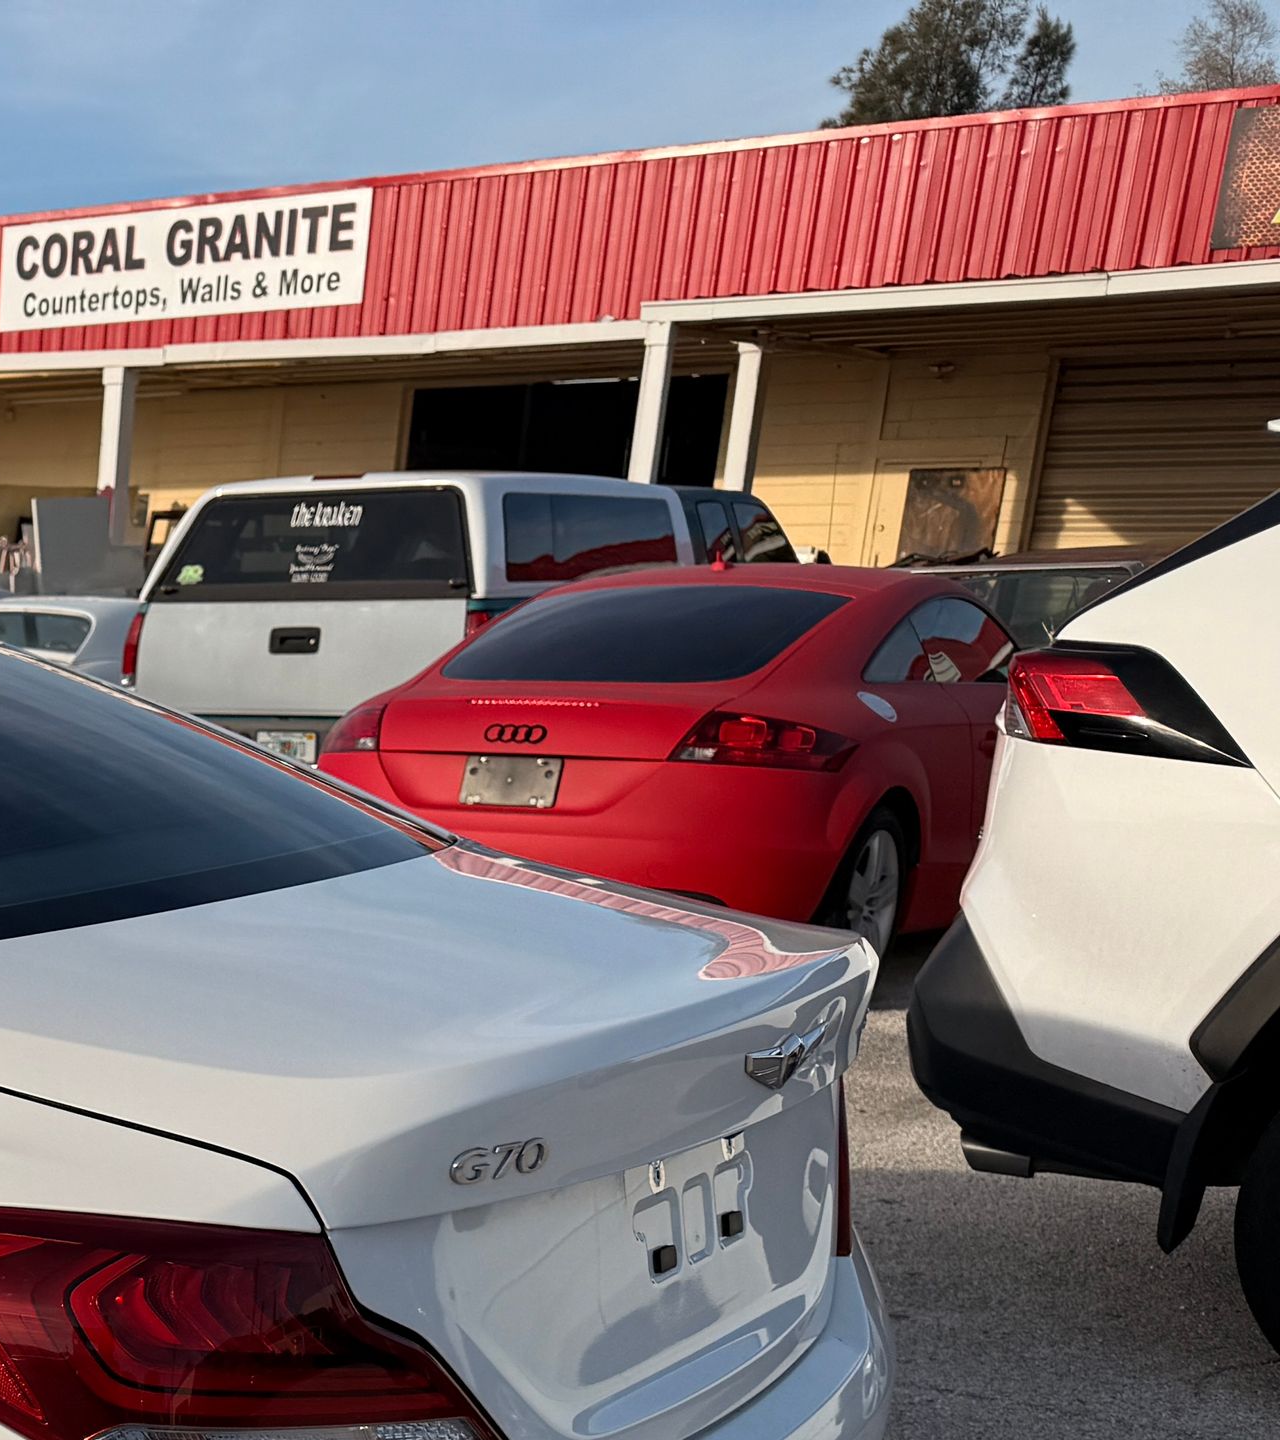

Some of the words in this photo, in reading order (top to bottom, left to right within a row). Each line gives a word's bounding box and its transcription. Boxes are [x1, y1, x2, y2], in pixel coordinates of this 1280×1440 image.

[16, 225, 144, 280] CORAL
[167, 202, 357, 267] GRANITE
[23, 283, 168, 318] Countertops,
[179, 273, 242, 306] Walls
[251, 271, 268, 298] &
[279, 268, 341, 297] More
[449, 1137, 550, 1186] G70
